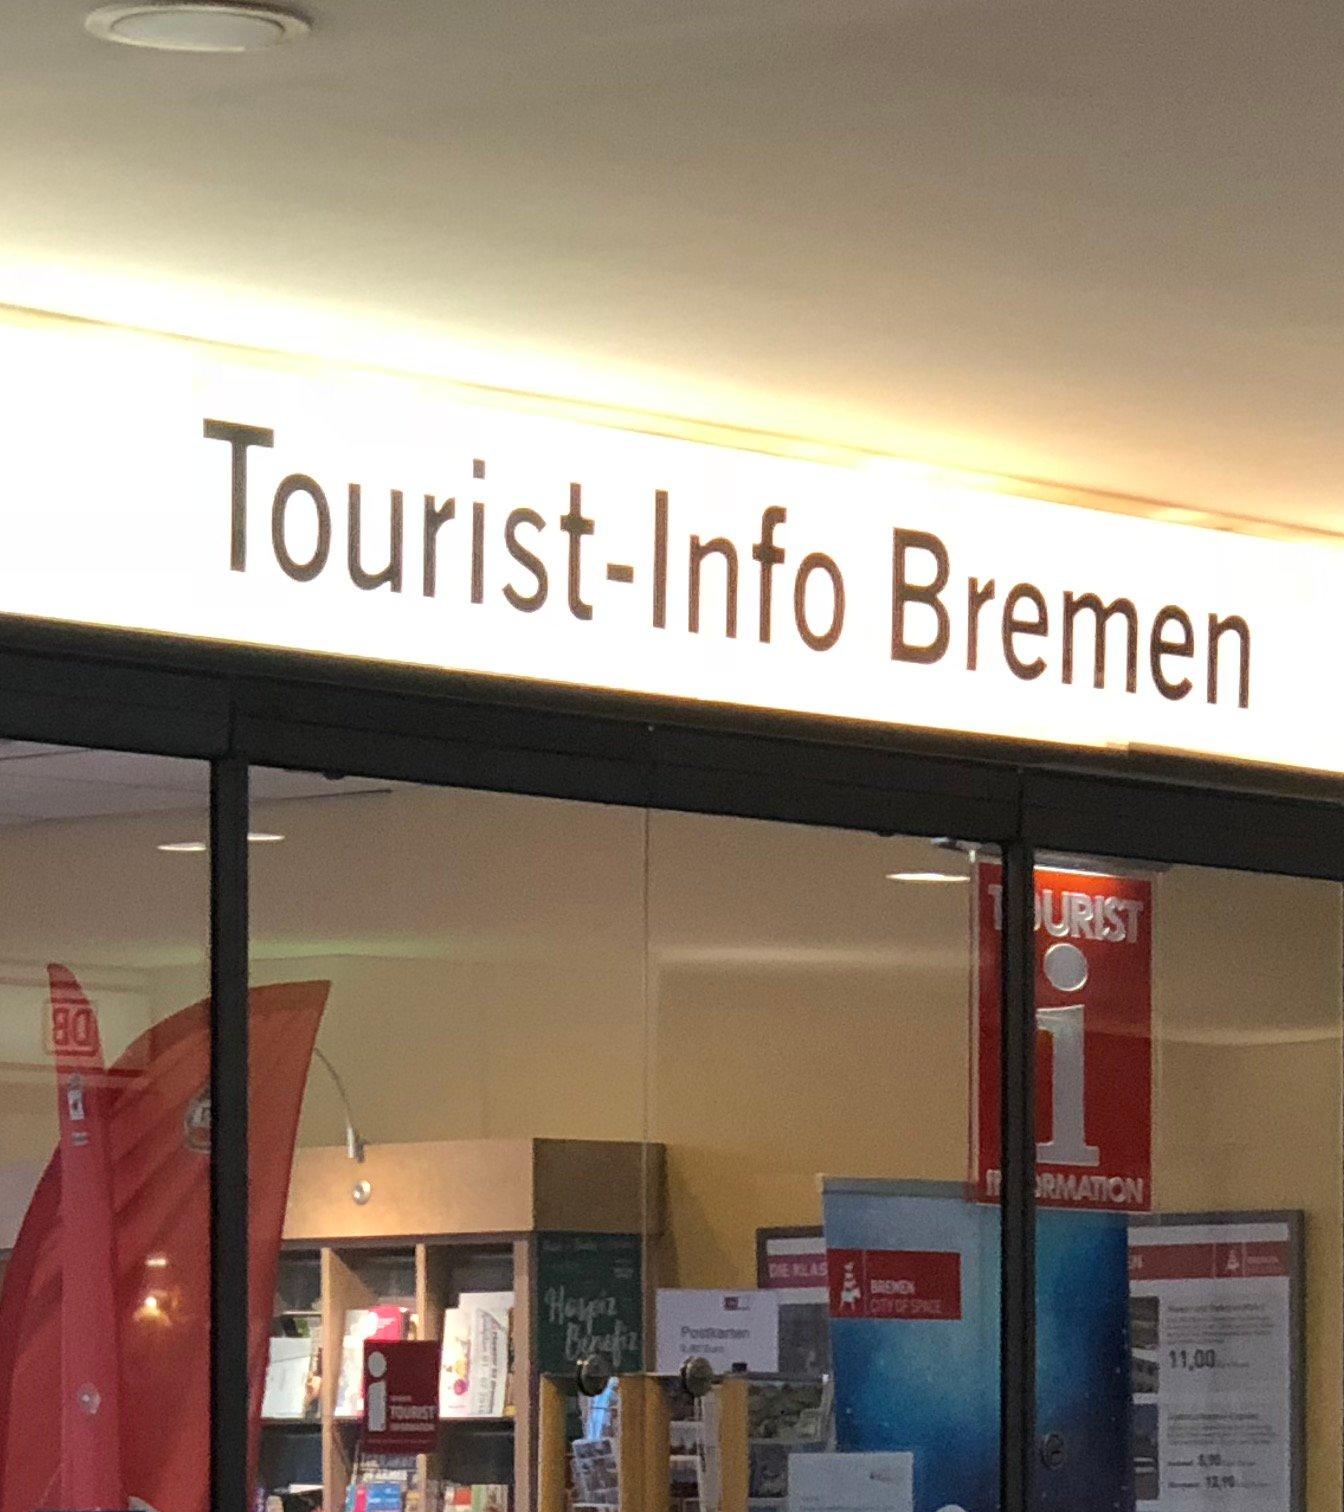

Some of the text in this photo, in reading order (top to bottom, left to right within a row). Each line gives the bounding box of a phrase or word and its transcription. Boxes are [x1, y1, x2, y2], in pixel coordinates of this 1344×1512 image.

[203, 418, 1250, 708] Tourist-Info Bremen
[987, 885, 1143, 944] TURIST
[1168, 1349, 1216, 1372] 11,00
